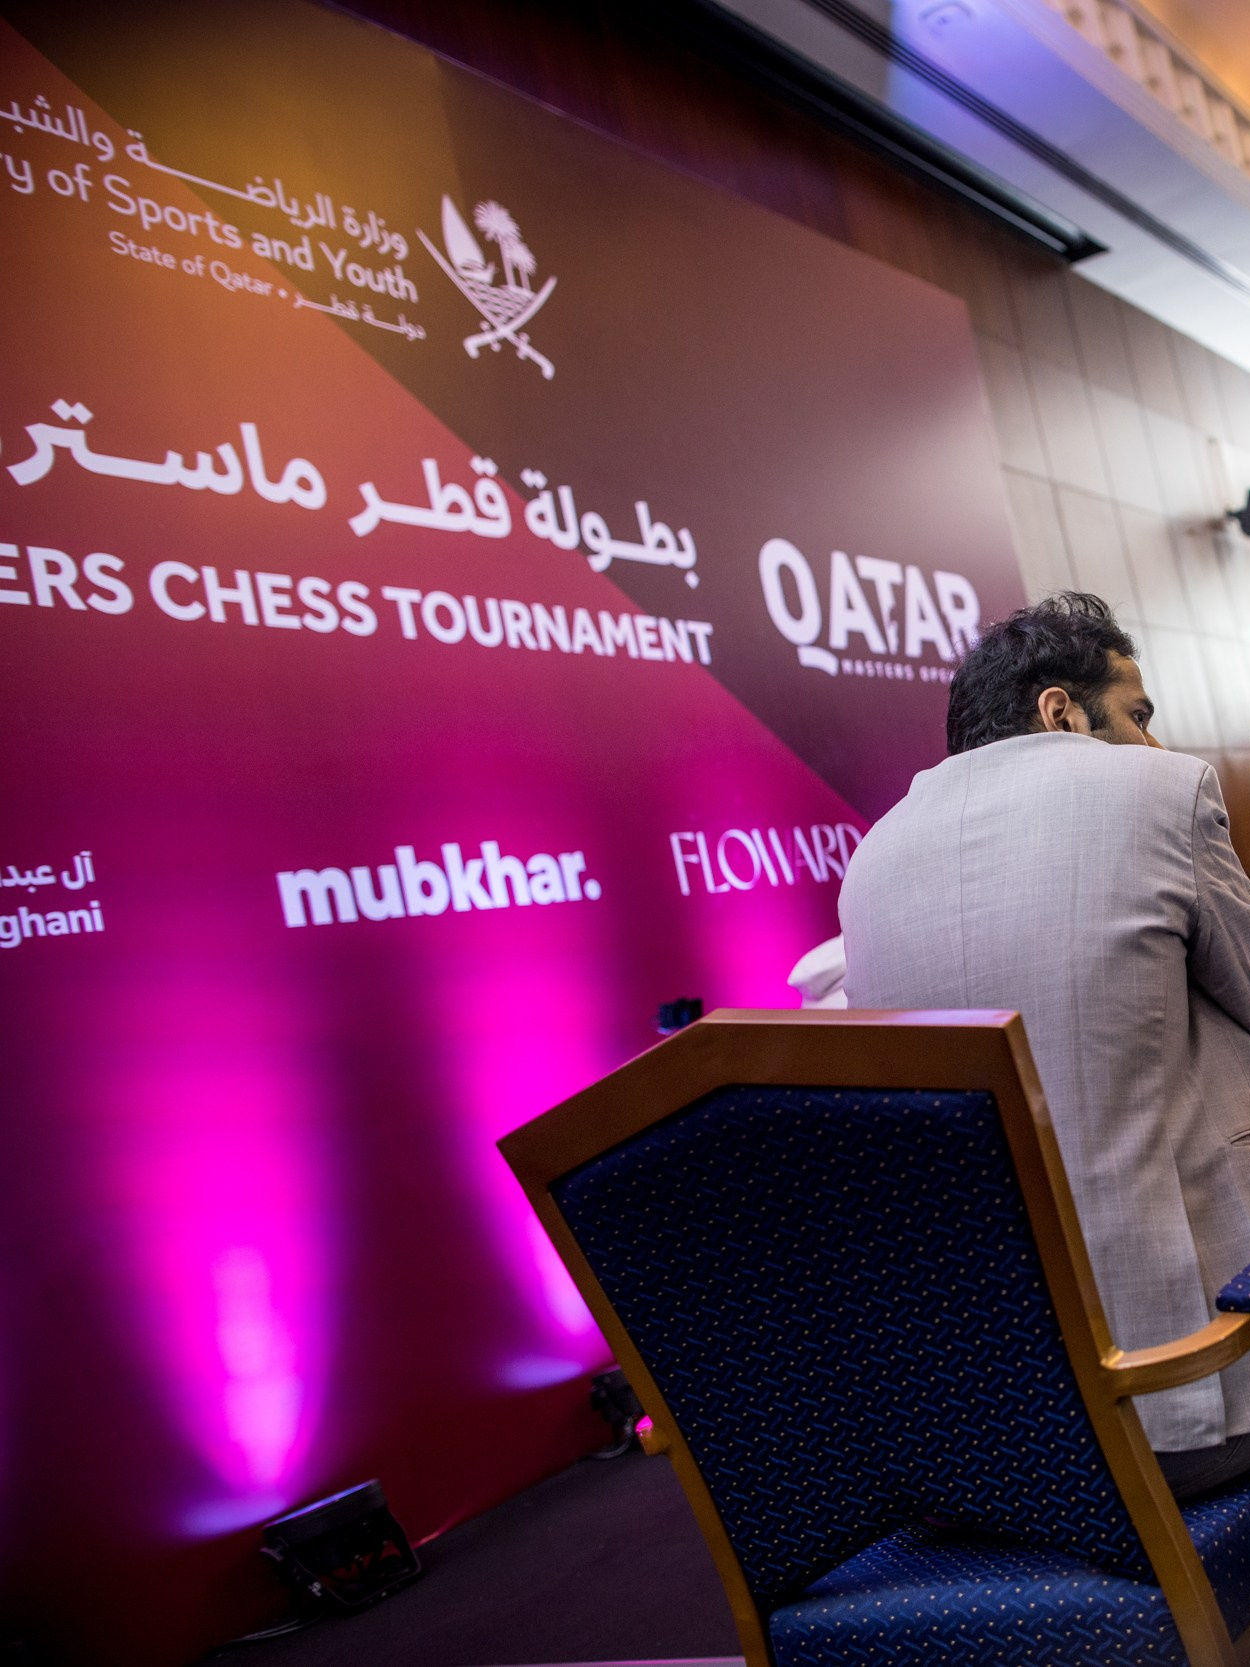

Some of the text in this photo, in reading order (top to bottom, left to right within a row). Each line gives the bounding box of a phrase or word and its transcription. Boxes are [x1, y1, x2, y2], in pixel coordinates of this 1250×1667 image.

[47, 162, 93, 203] of
[103, 173, 243, 249] Sports
[251, 232, 315, 272] and
[318, 241, 419, 304] Youth
[108, 230, 273, 297] State of Qatar
[341, 205, 409, 261] وزارة
[347, 455, 513, 538] قطر
[521, 467, 700, 590] بطولة
[149, 560, 378, 638] CHESS
[381, 585, 713, 665] TOURNAMENT
[758, 538, 981, 677] QATAR
[61, 850, 96, 891] آل
[275, 840, 602, 928] mubkhar.
